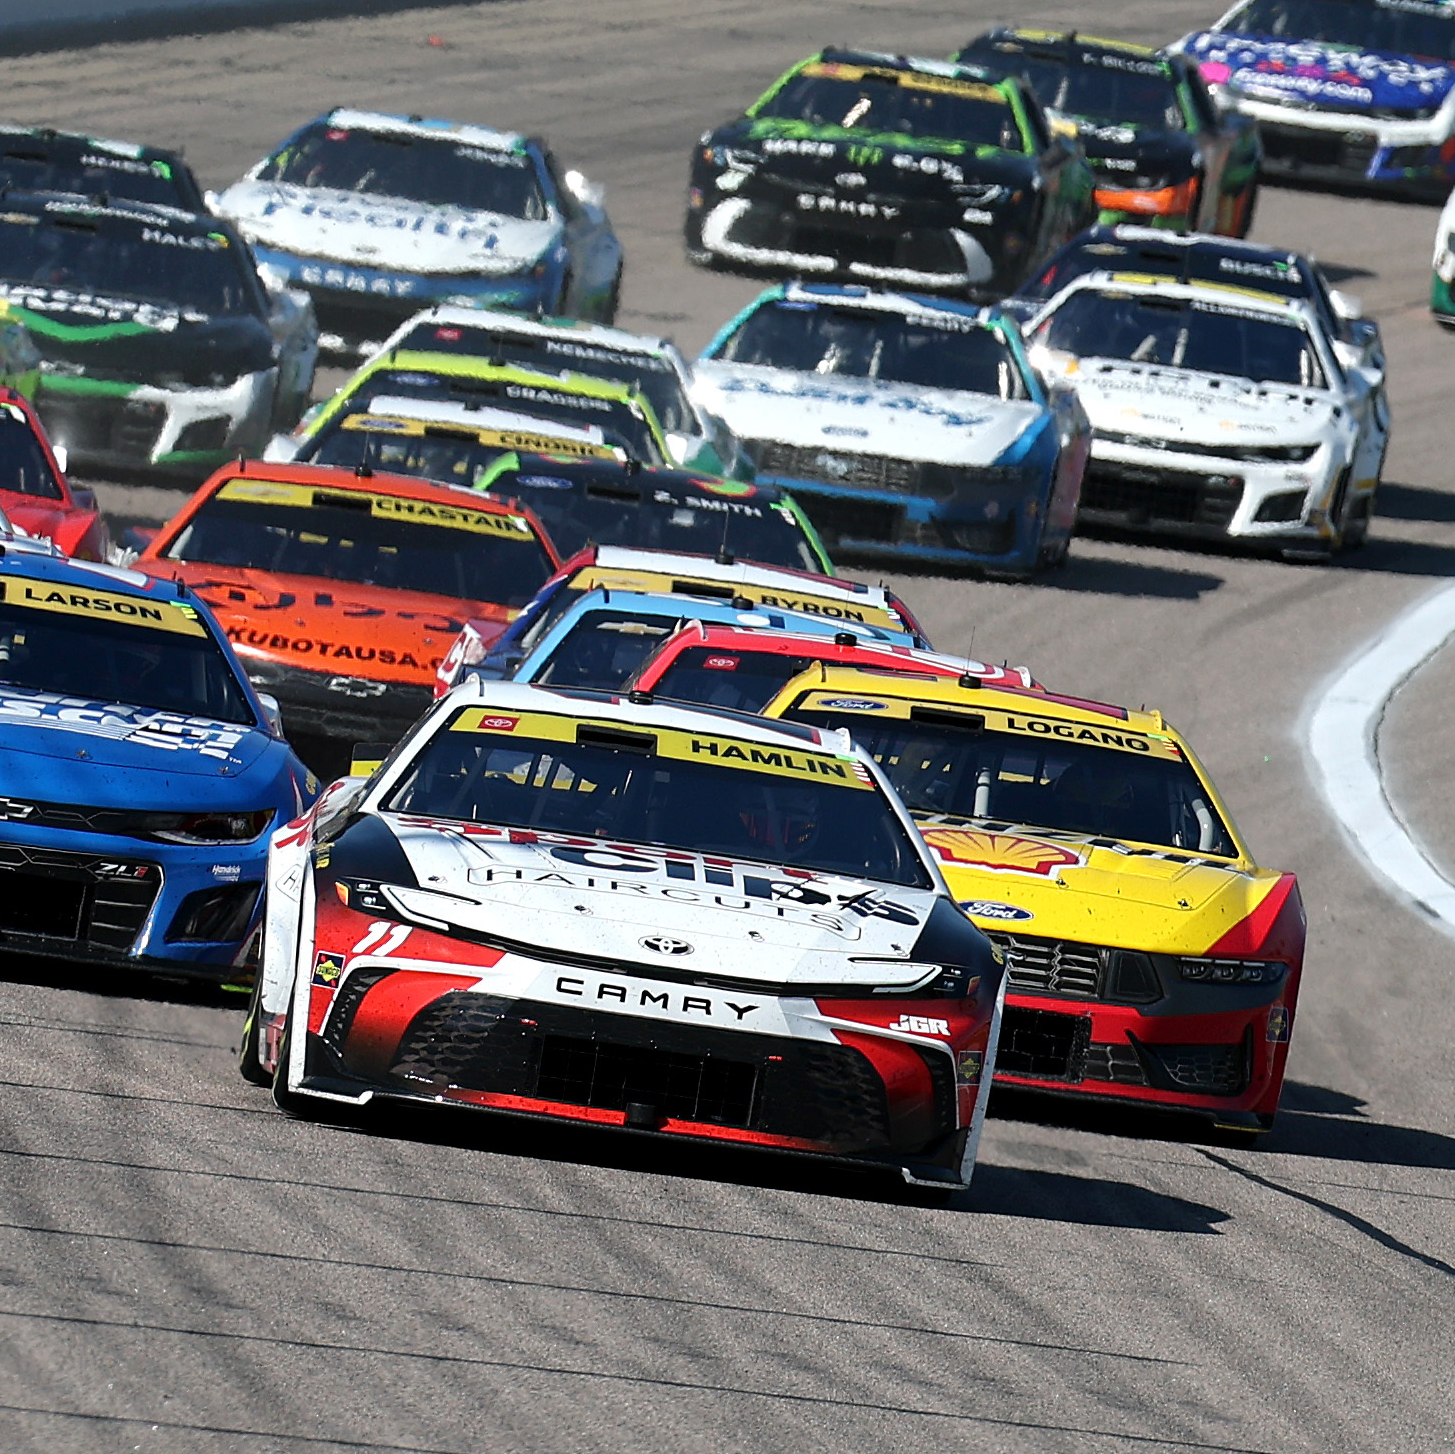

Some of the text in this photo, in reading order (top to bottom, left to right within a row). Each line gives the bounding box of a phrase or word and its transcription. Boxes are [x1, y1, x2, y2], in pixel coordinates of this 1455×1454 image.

[376, 498, 524, 534] CHASTAIN
[684, 495, 763, 517] SMITH
[25, 587, 162, 620] LARSON
[760, 594, 865, 623] BYRON
[1007, 717, 1150, 752] LOGANO
[690, 737, 847, 779] HAMLIN
[94, 862, 149, 878] ZL1
[212, 864, 242, 875] Hendrick
[485, 868, 845, 932] HAIRCUTS
[352, 921, 413, 957] 11
[316, 963, 340, 978] SUNOCO
[556, 976, 760, 1021] CAMRY
[889, 1014, 951, 1036] JGR
